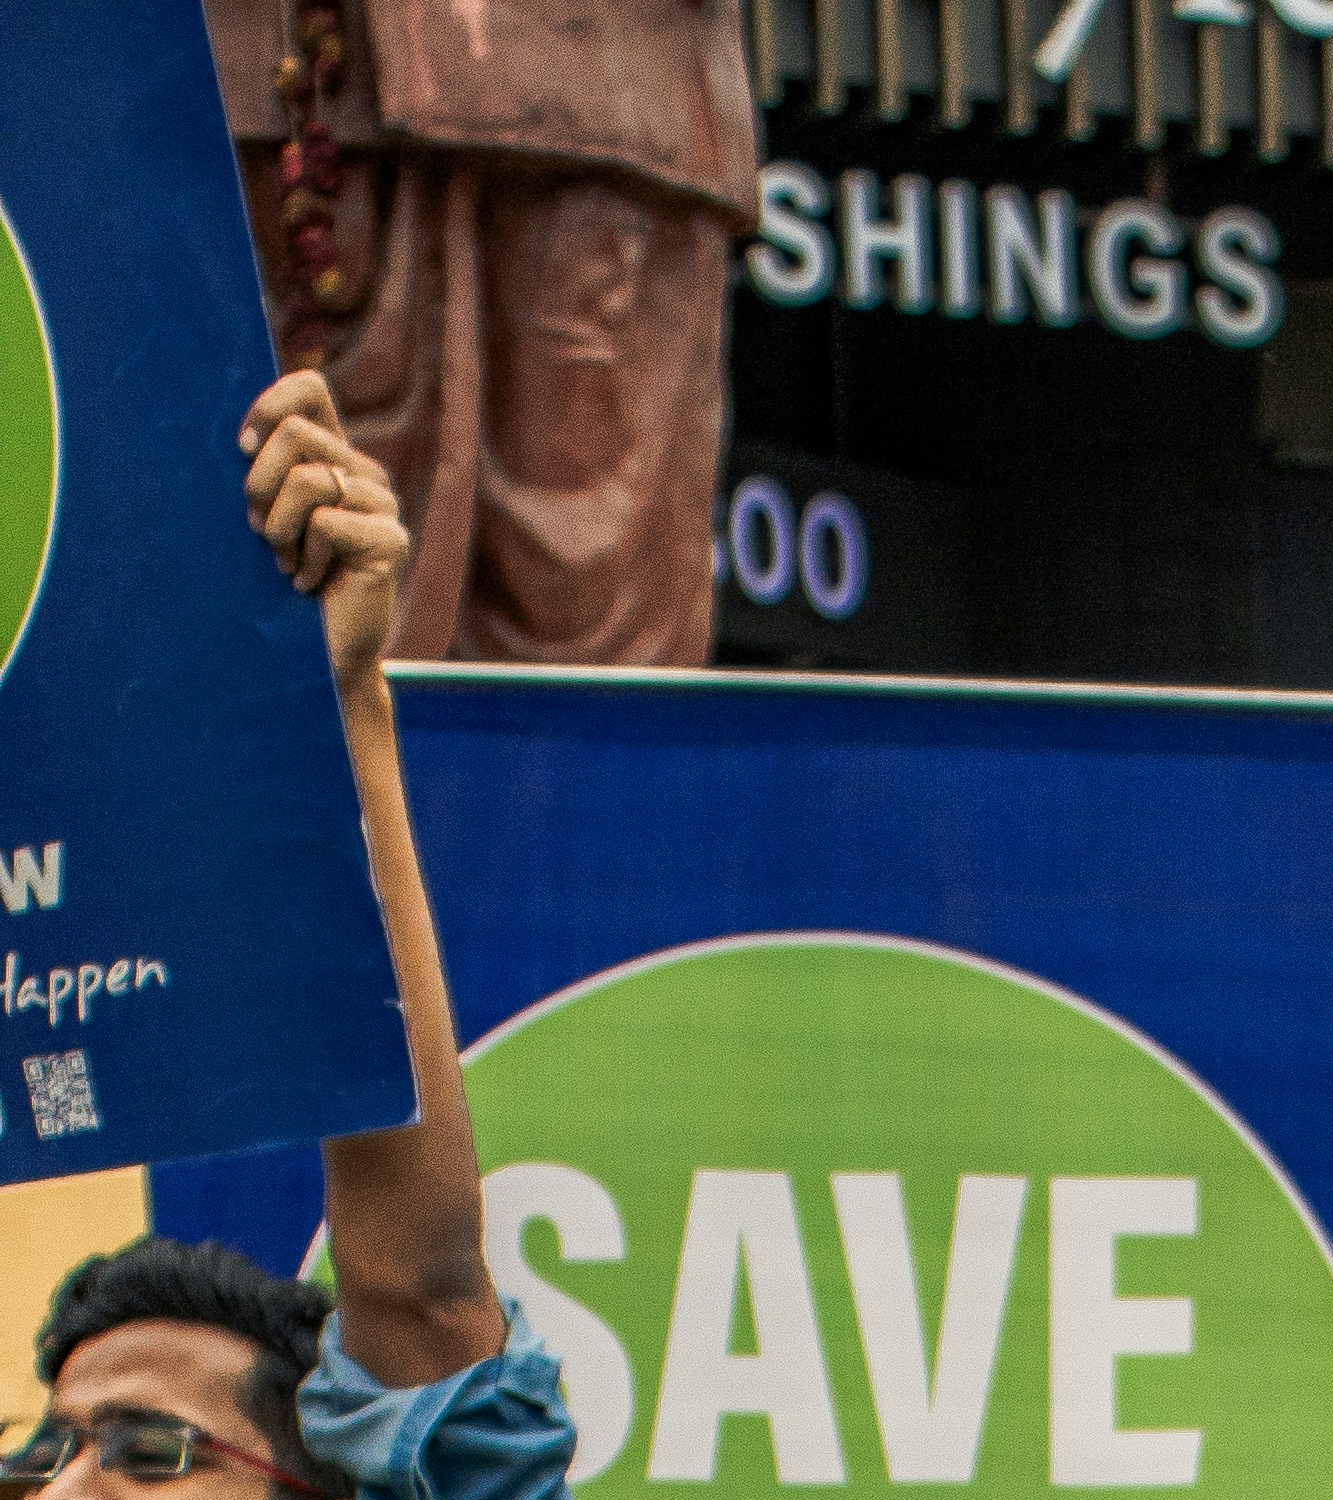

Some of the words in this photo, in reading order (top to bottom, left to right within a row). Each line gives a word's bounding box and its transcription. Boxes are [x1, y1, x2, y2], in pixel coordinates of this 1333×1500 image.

[747, 160, 1286, 348] SHINGS
[712, 474, 871, 621] 00
[481, 1162, 1201, 1489] SAVE
